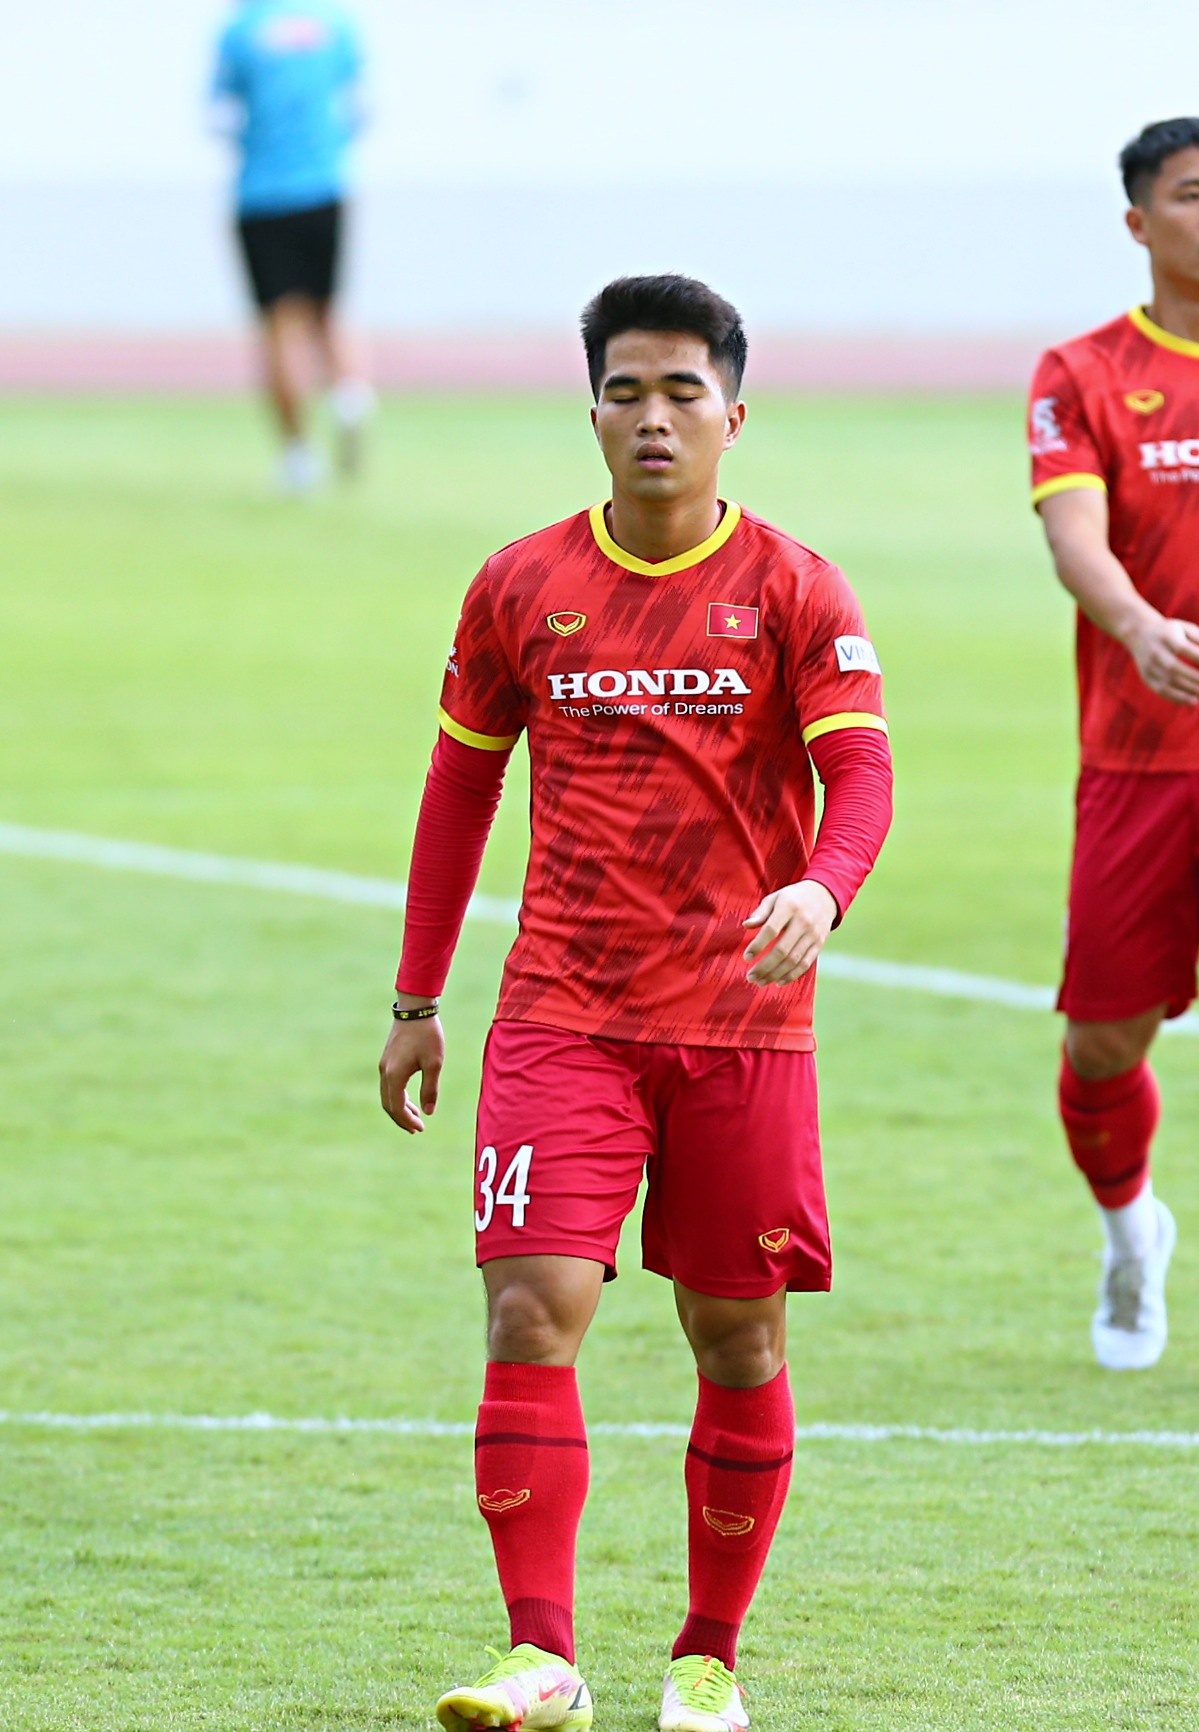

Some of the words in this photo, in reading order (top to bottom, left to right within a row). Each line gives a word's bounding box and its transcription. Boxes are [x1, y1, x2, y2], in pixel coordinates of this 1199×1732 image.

[547, 668, 752, 700] HONDA
[558, 706, 590, 718] The
[592, 704, 648, 716] Power
[650, 702, 671, 715] of
[675, 702, 744, 715] Dreams
[475, 1145, 534, 1232] 34
